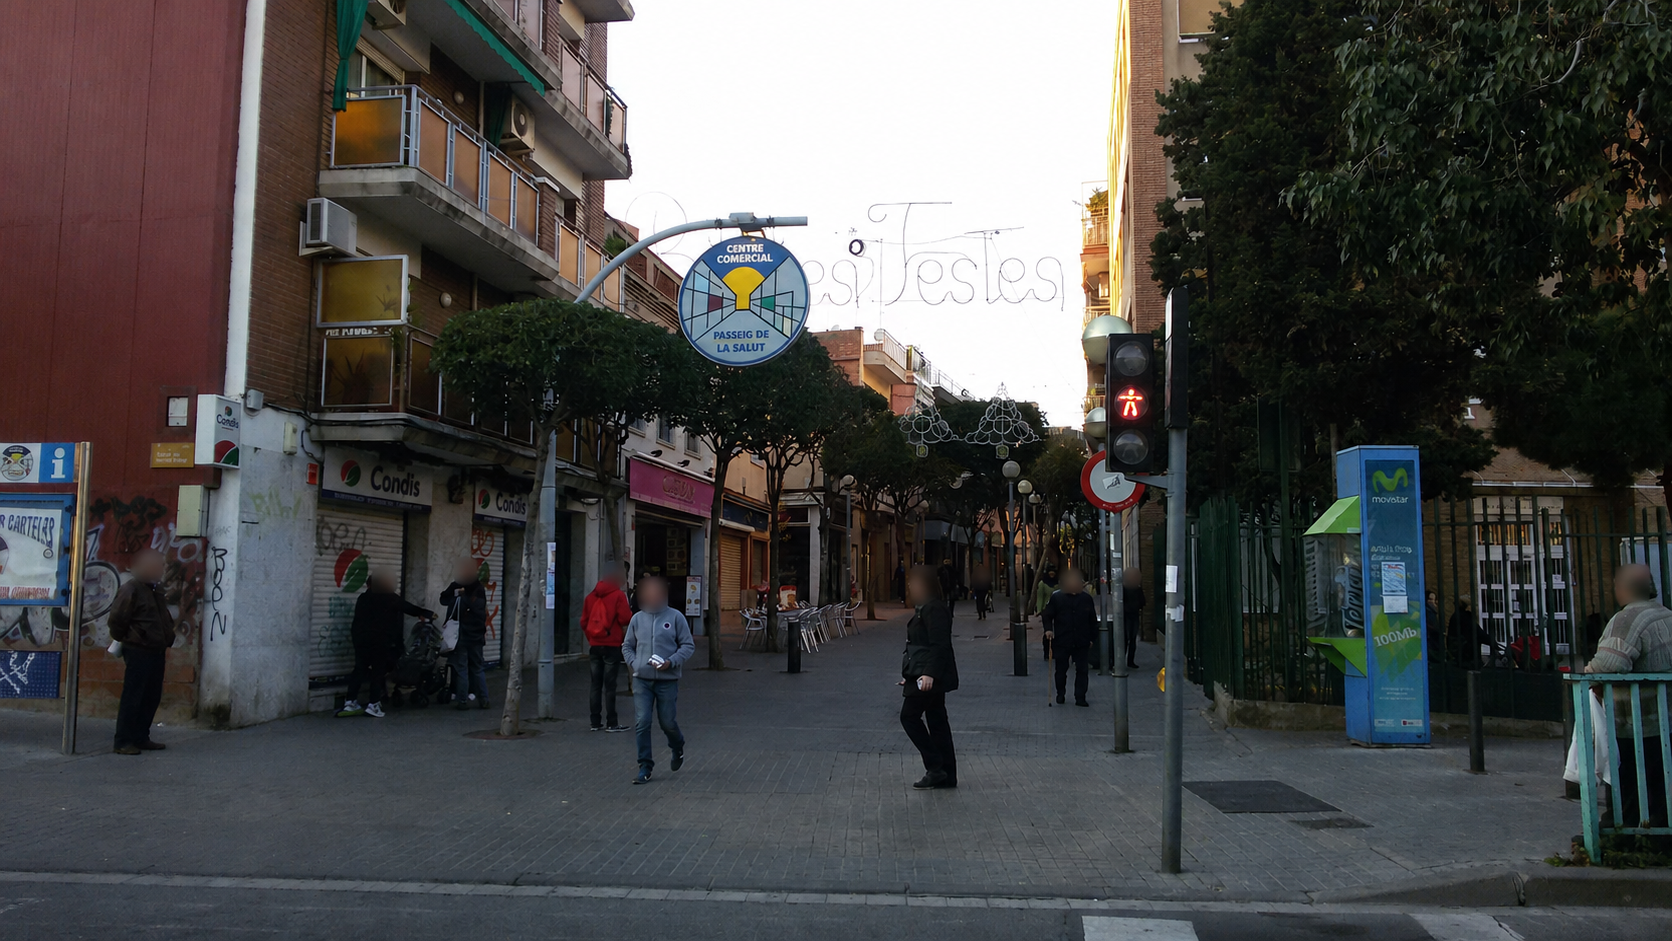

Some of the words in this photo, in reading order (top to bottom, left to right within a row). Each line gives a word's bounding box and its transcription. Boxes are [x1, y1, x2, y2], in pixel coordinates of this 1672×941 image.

[726, 243, 764, 253] CENTRE
[716, 252, 774, 264] COMERCIAL
[713, 330, 753, 340] PASSEIG
[755, 329, 770, 339] DE
[716, 343, 730, 353] LA
[732, 342, 766, 353] SALUT
[370, 465, 420, 497] Condis
[496, 491, 527, 515] Condis
[1374, 626, 1418, 648] 100Mb
